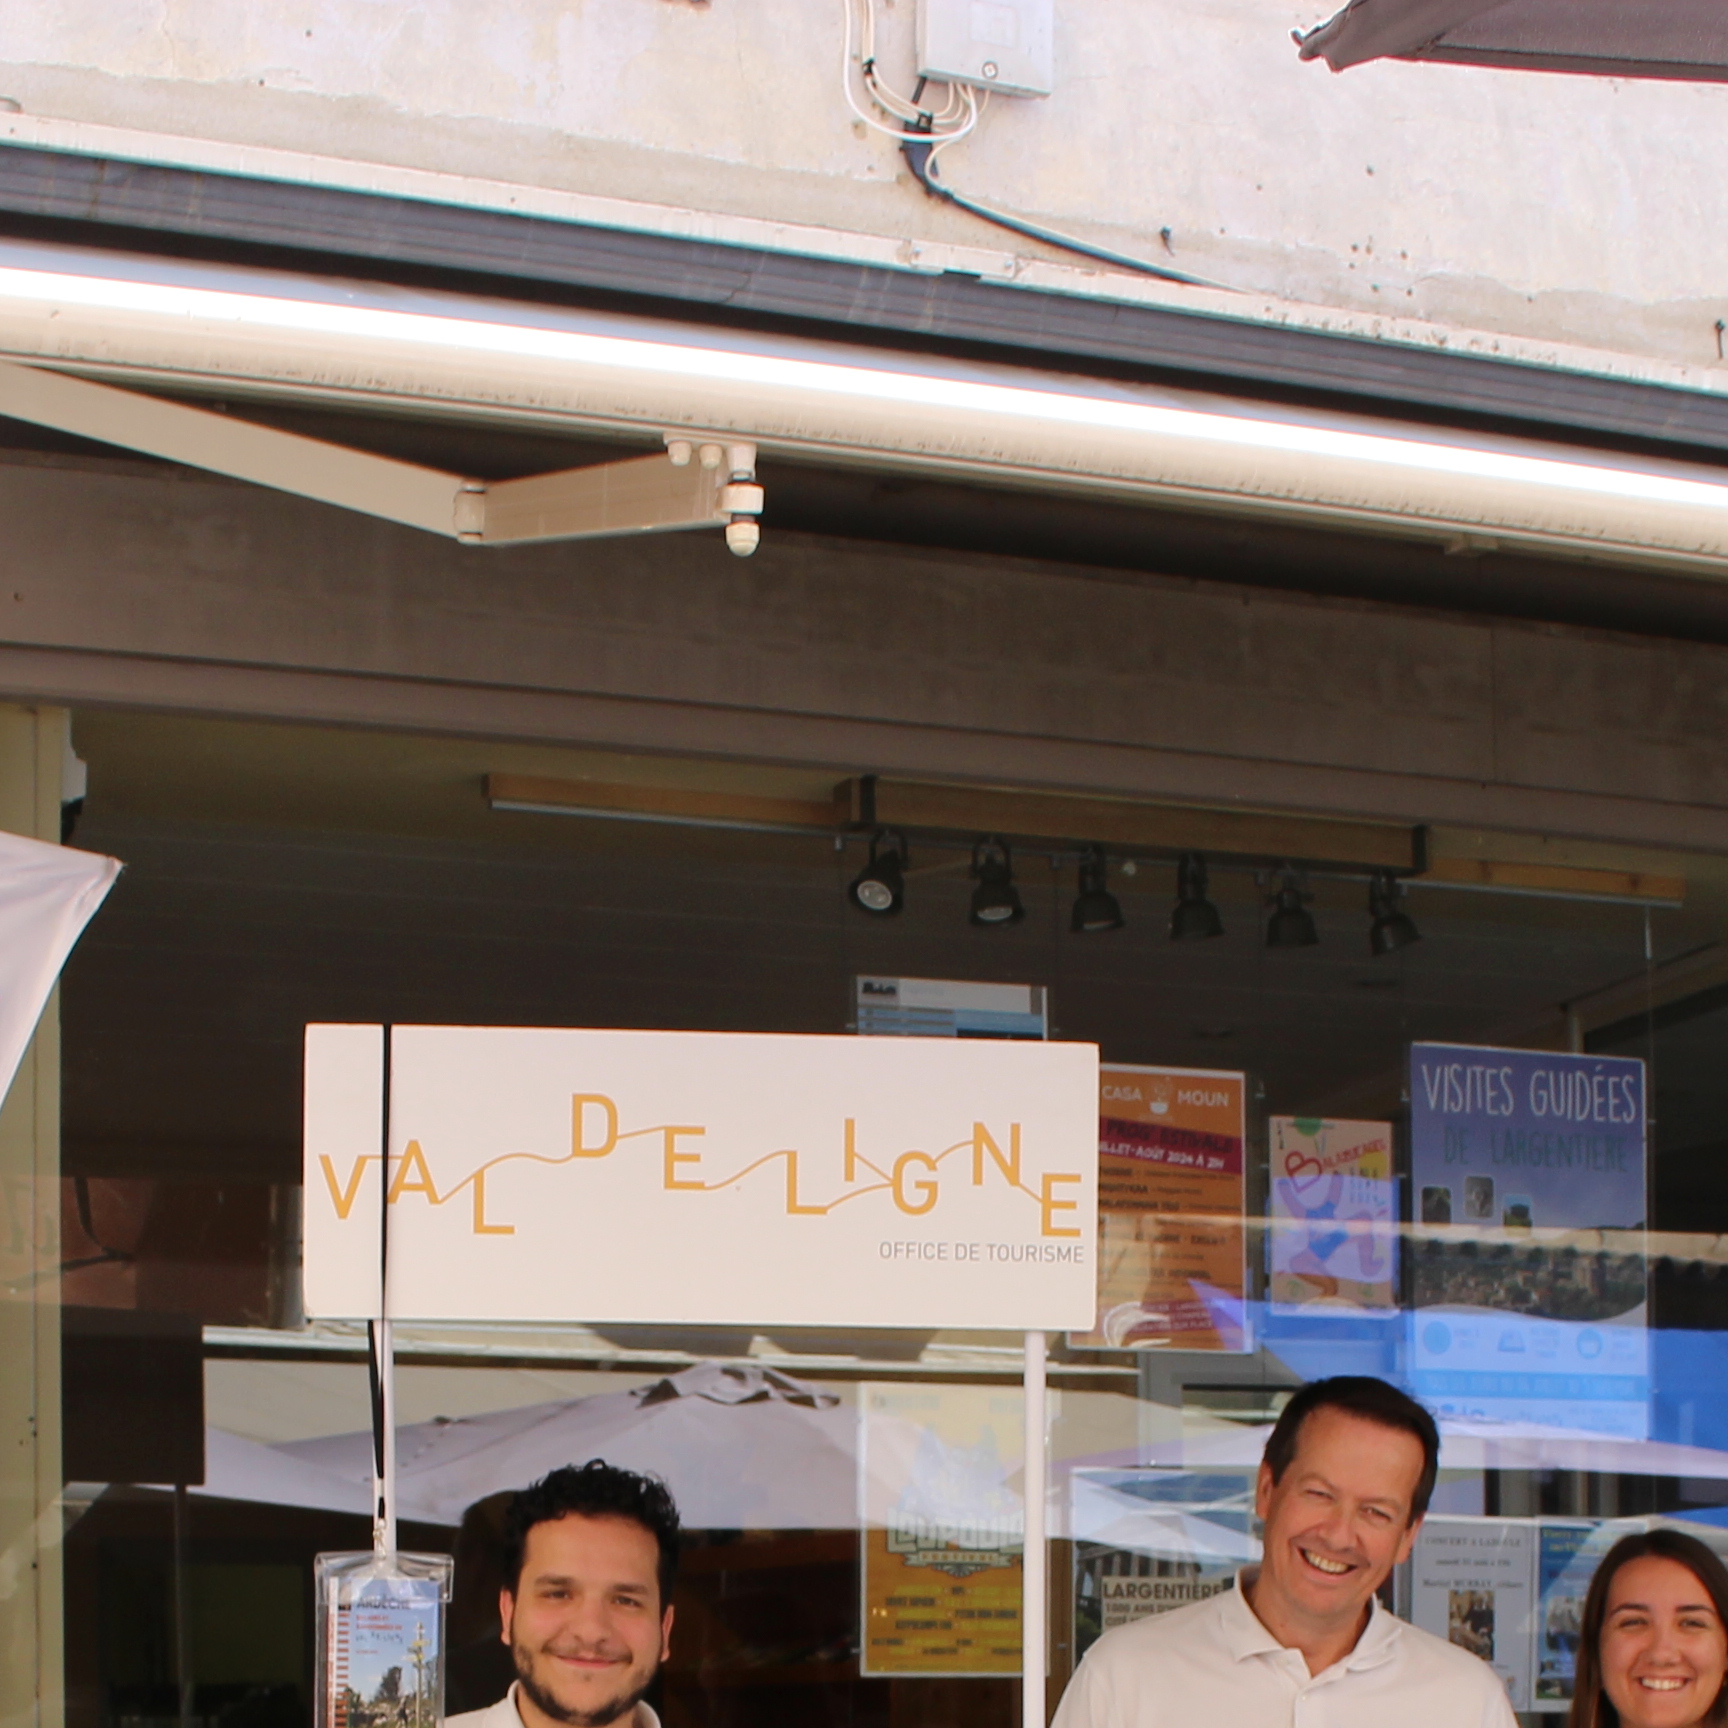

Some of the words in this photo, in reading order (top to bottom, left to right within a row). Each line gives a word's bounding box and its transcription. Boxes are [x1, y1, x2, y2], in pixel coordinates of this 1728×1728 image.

[1101, 1085, 1143, 1101] CASA
[1177, 1089, 1230, 1107] MOUN
[1421, 1063, 1515, 1116] VISITES
[1528, 1064, 1637, 1125] GUIDÉES
[318, 1139, 515, 1235] VAL
[572, 1092, 706, 1191] DE
[785, 1117, 1081, 1237] LIGNE
[878, 1240, 949, 1261] OFFICE
[954, 1242, 981, 1262] DE
[986, 1242, 1085, 1264] TOURISME
